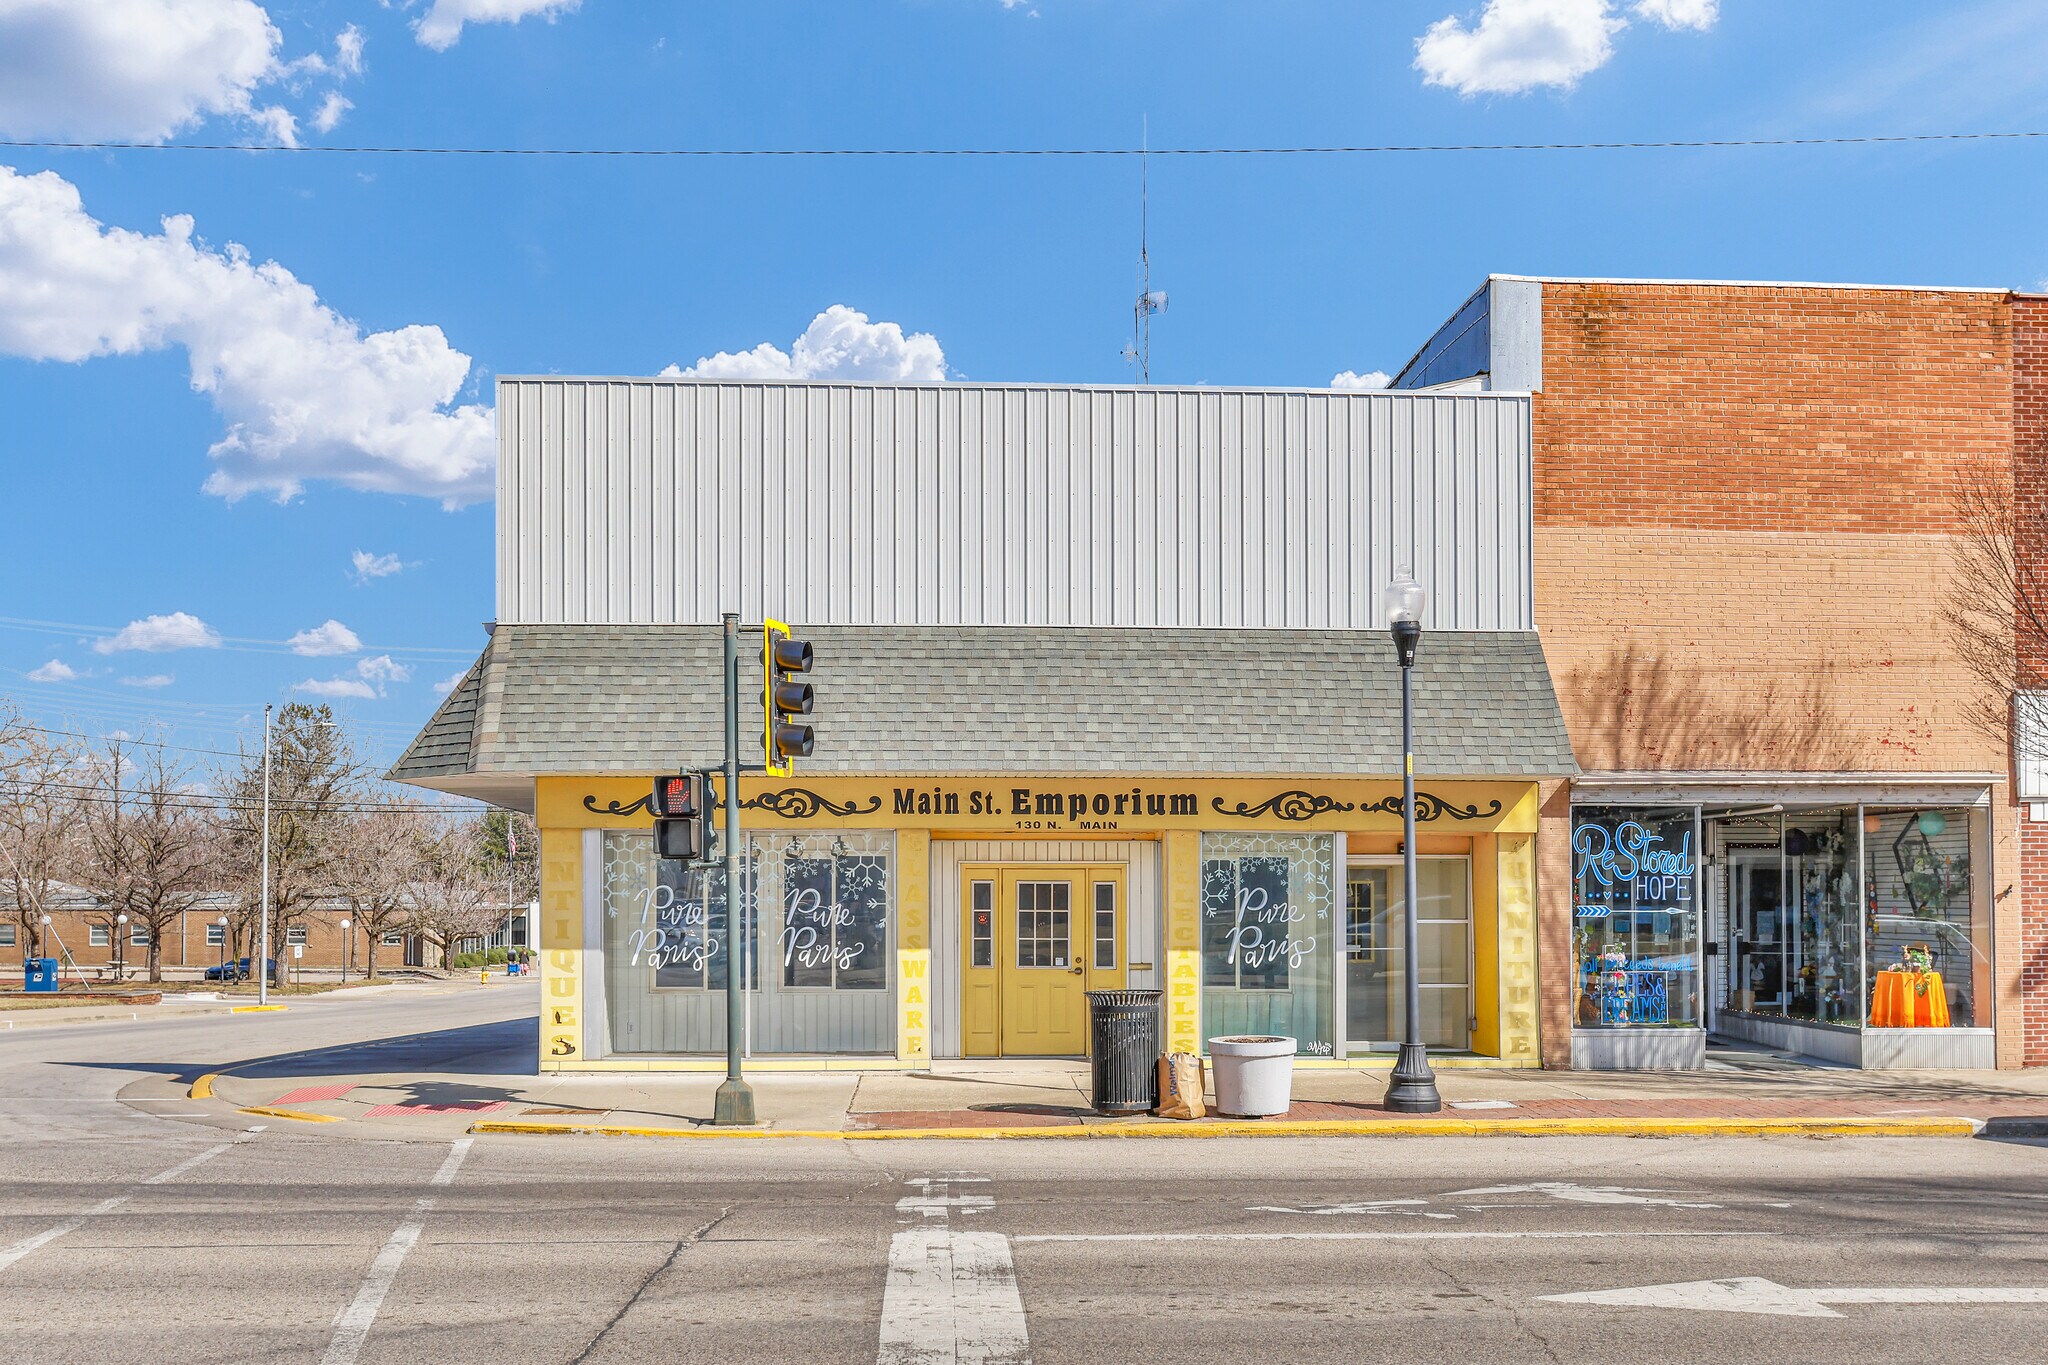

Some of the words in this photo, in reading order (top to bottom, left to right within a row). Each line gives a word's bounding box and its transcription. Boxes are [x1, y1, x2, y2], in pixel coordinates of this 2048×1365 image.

[893, 787, 959, 815] Main
[970, 790, 1001, 815] St.
[1011, 788, 1198, 821] Emporium
[1015, 821, 1041, 829] 130
[1047, 821, 1062, 829] N.
[1080, 821, 1118, 829] MAIN
[634, 885, 708, 925] Pure
[784, 888, 856, 927] Pure
[1234, 887, 1305, 924] Pure
[1636, 876, 1692, 901] HOPE
[547, 846, 577, 1056] NTIQUES
[629, 928, 719, 971] Paris
[777, 927, 864, 969] Paris
[902, 836, 926, 1054] LASSWARE
[1171, 838, 1197, 1053] LLECTABLES
[1225, 926, 1316, 968] Paris
[1505, 846, 1532, 1054] URNITURE
[1605, 956, 1654, 972] pceeds
[1605, 973, 1655, 997] PES
